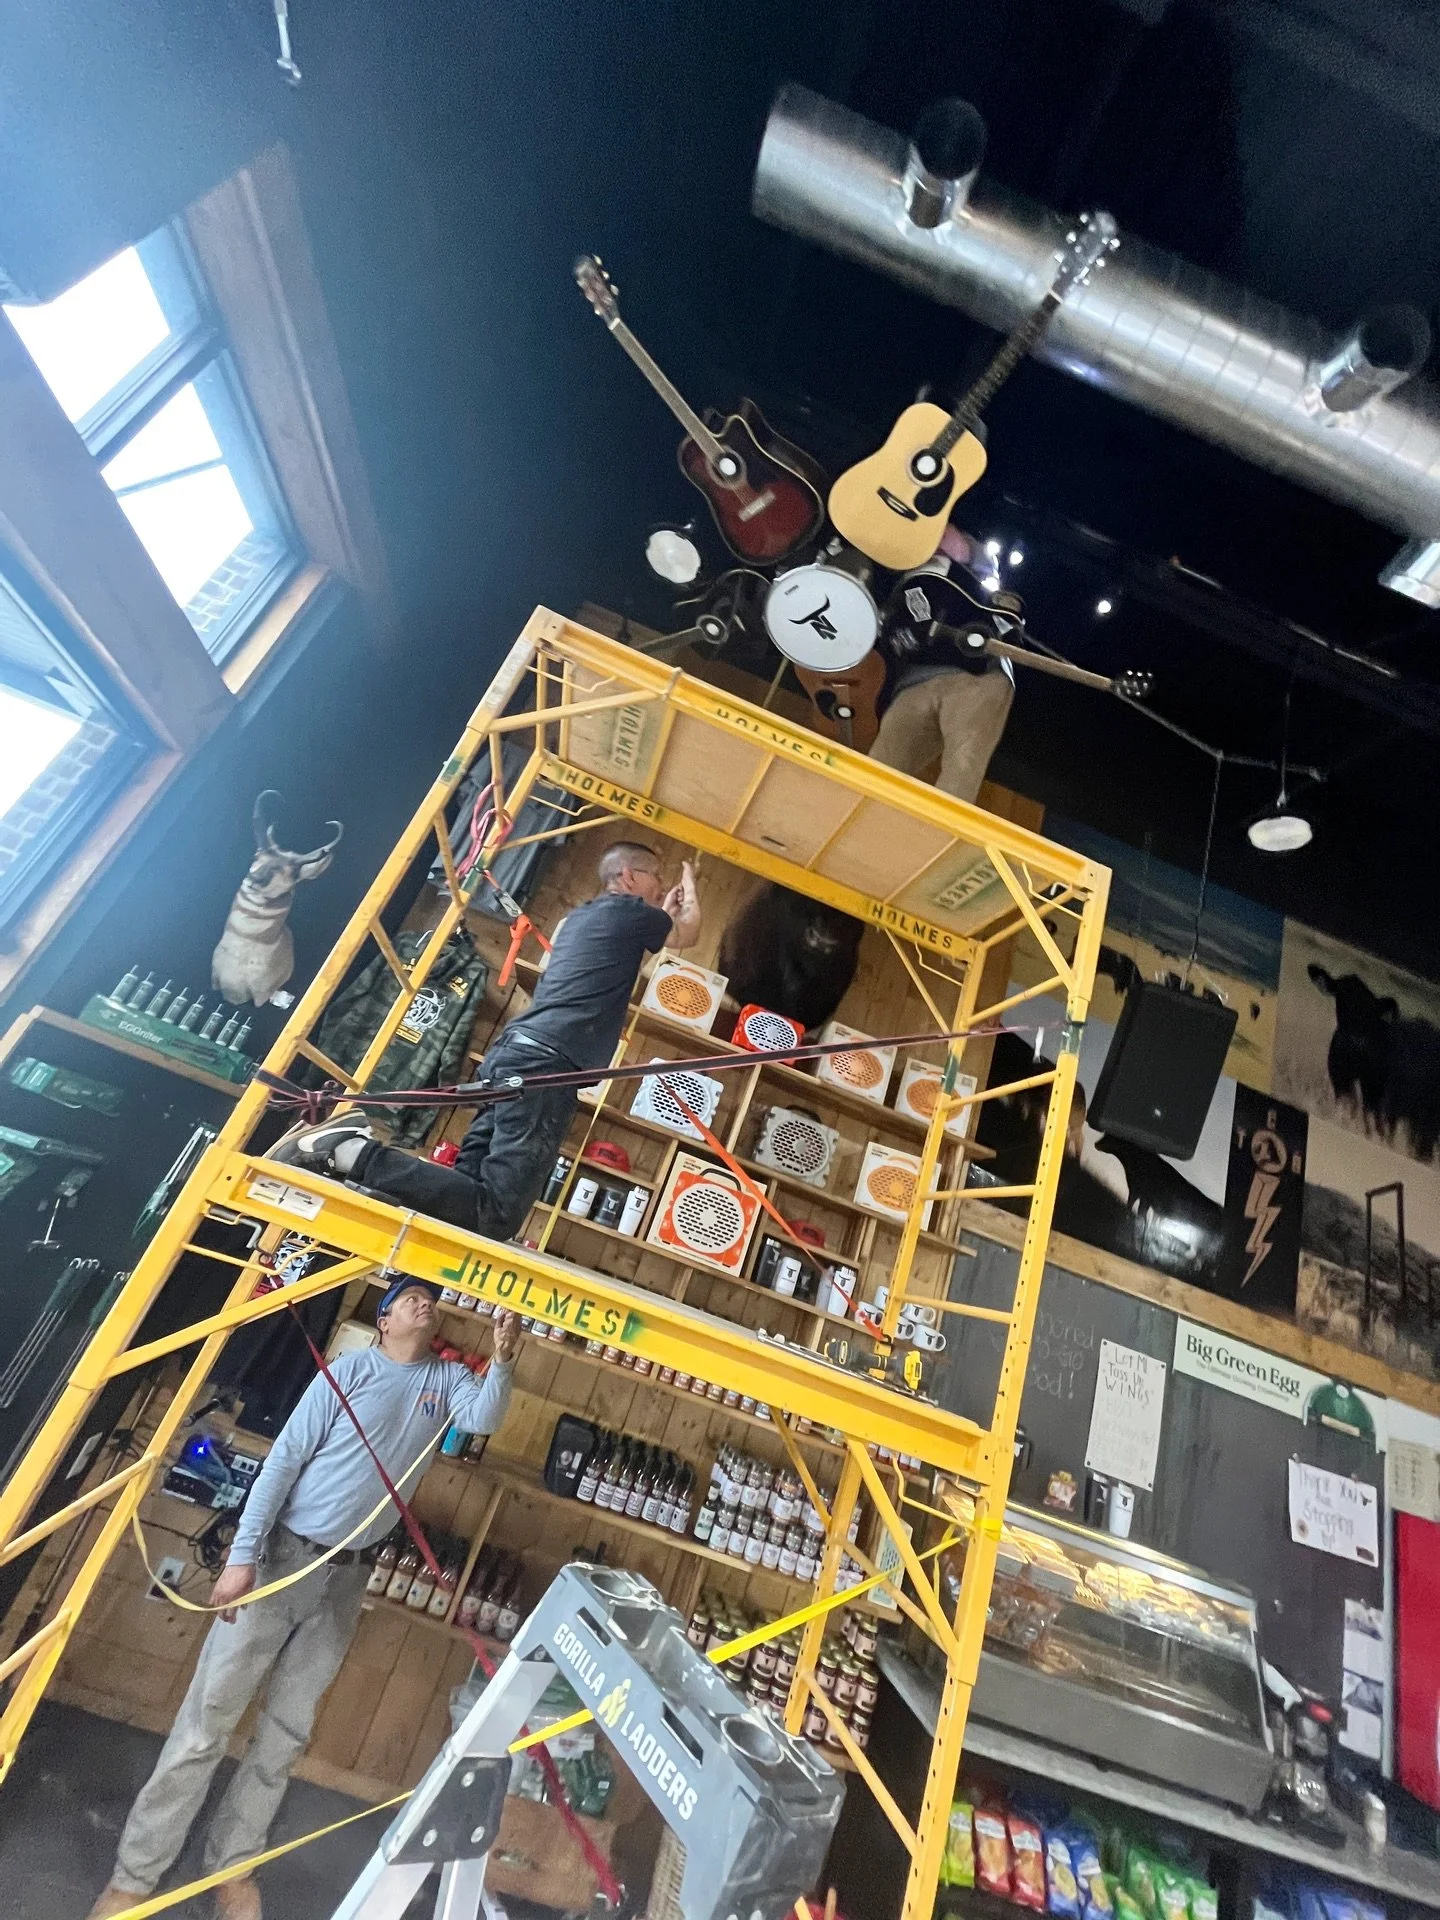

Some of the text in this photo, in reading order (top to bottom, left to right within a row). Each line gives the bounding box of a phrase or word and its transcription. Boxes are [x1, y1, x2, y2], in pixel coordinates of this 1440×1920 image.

[566, 769, 655, 816] HOLMES
[939, 865, 994, 906] OLMES
[872, 903, 953, 949] HOLMES
[467, 1259, 621, 1336] HOLMES
[1186, 1334, 1212, 1363] Big
[1216, 1348, 1267, 1381] Green
[1270, 1368, 1300, 1397] Egg
[553, 1623, 698, 1821] GORILLA LADDERS
